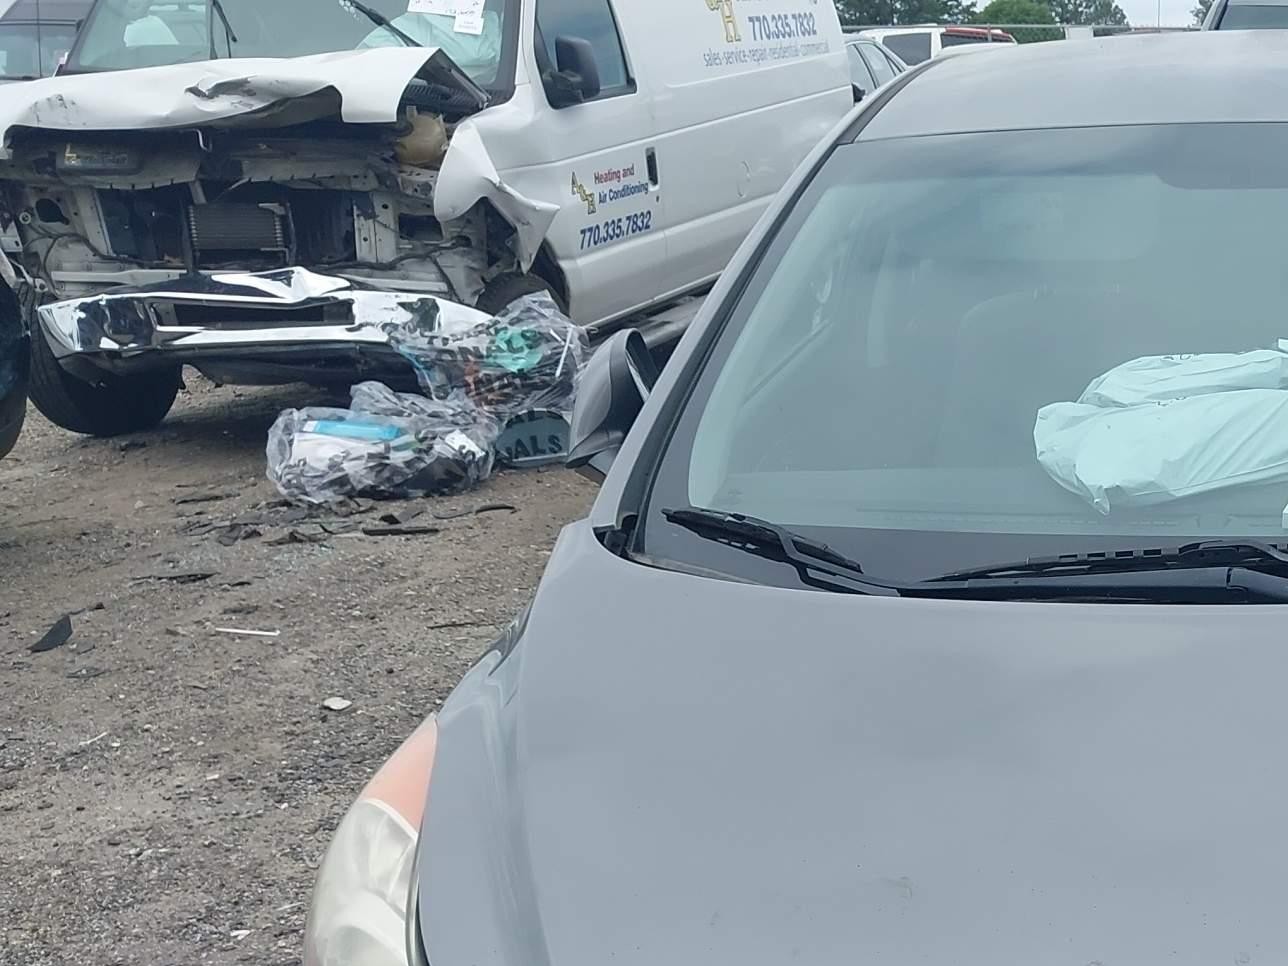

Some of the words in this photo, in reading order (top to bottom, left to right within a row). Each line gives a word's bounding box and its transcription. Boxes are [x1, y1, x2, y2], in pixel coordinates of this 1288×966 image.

[748, 12, 817, 41] 770.335.7832
[593, 168, 621, 185] Heating
[622, 163, 635, 177] and
[598, 191, 608, 204] Air
[608, 181, 649, 202] Conditioning
[580, 210, 652, 250] 770.335.7832
